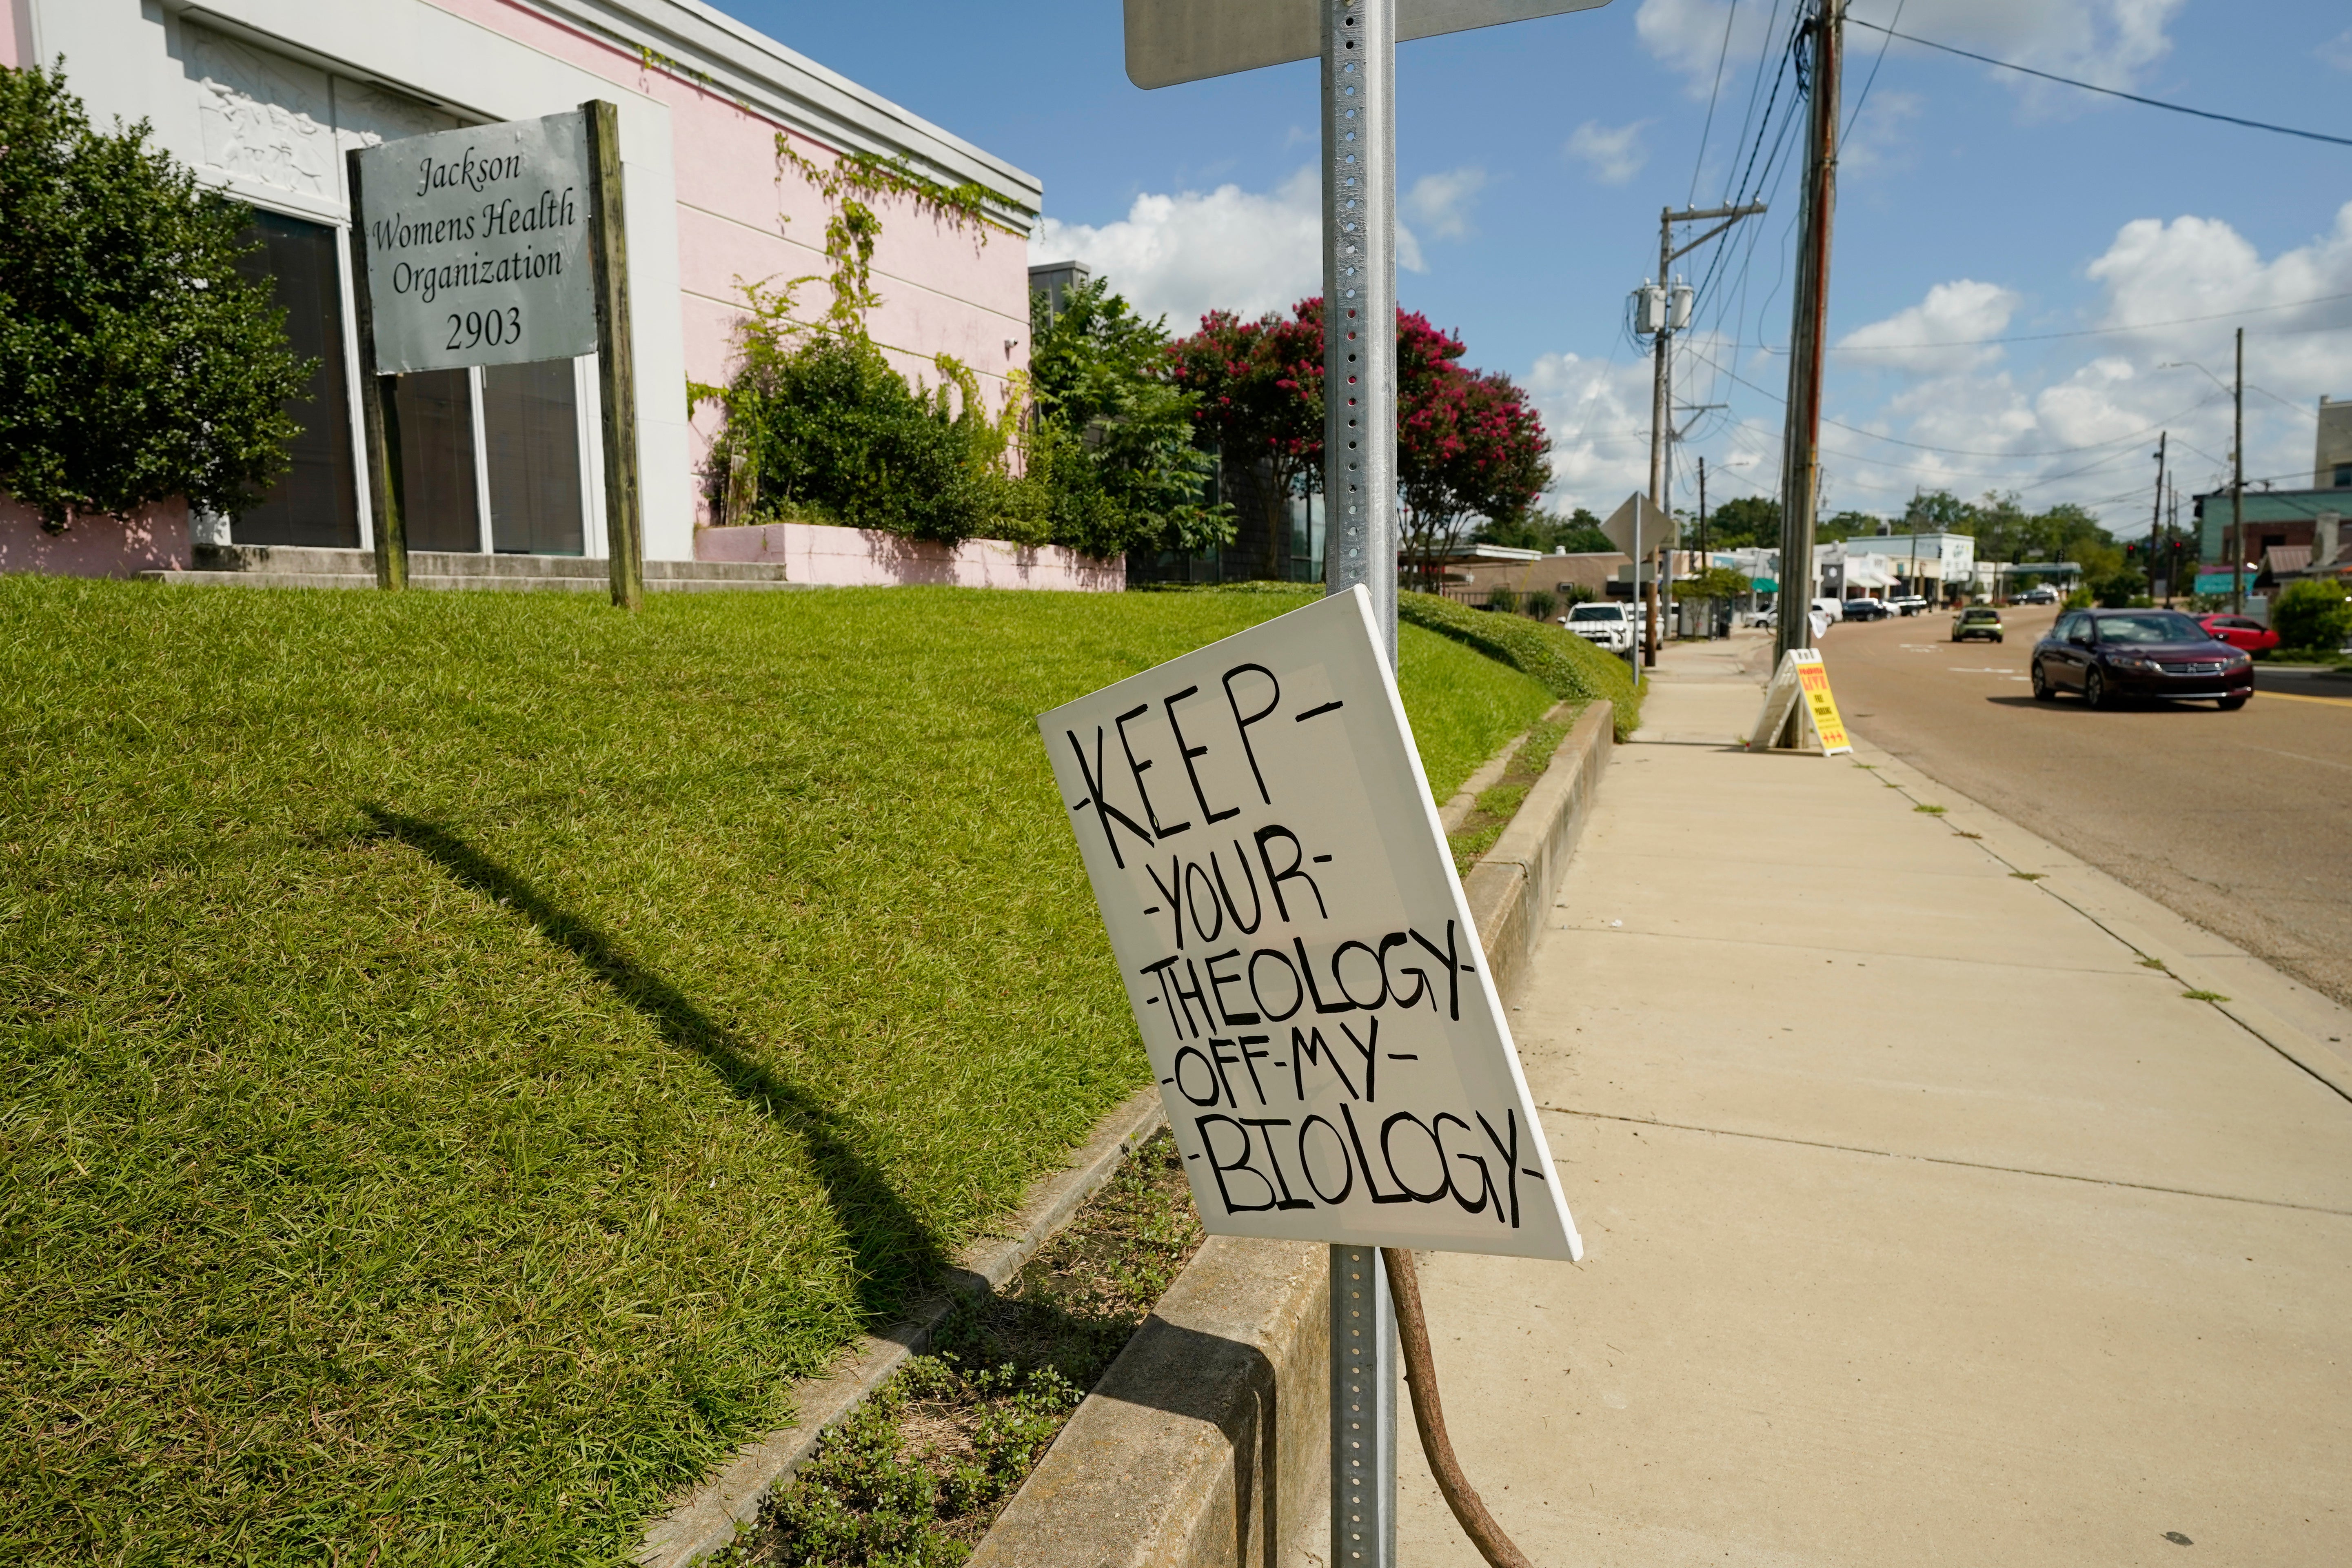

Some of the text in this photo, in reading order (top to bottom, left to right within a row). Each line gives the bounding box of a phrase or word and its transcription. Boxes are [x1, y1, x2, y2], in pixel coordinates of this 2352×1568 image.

[417, 146, 521, 197] Jackson
[372, 187, 575, 252] Womens Health
[393, 245, 563, 303] Organization
[446, 307, 521, 350] 2903
